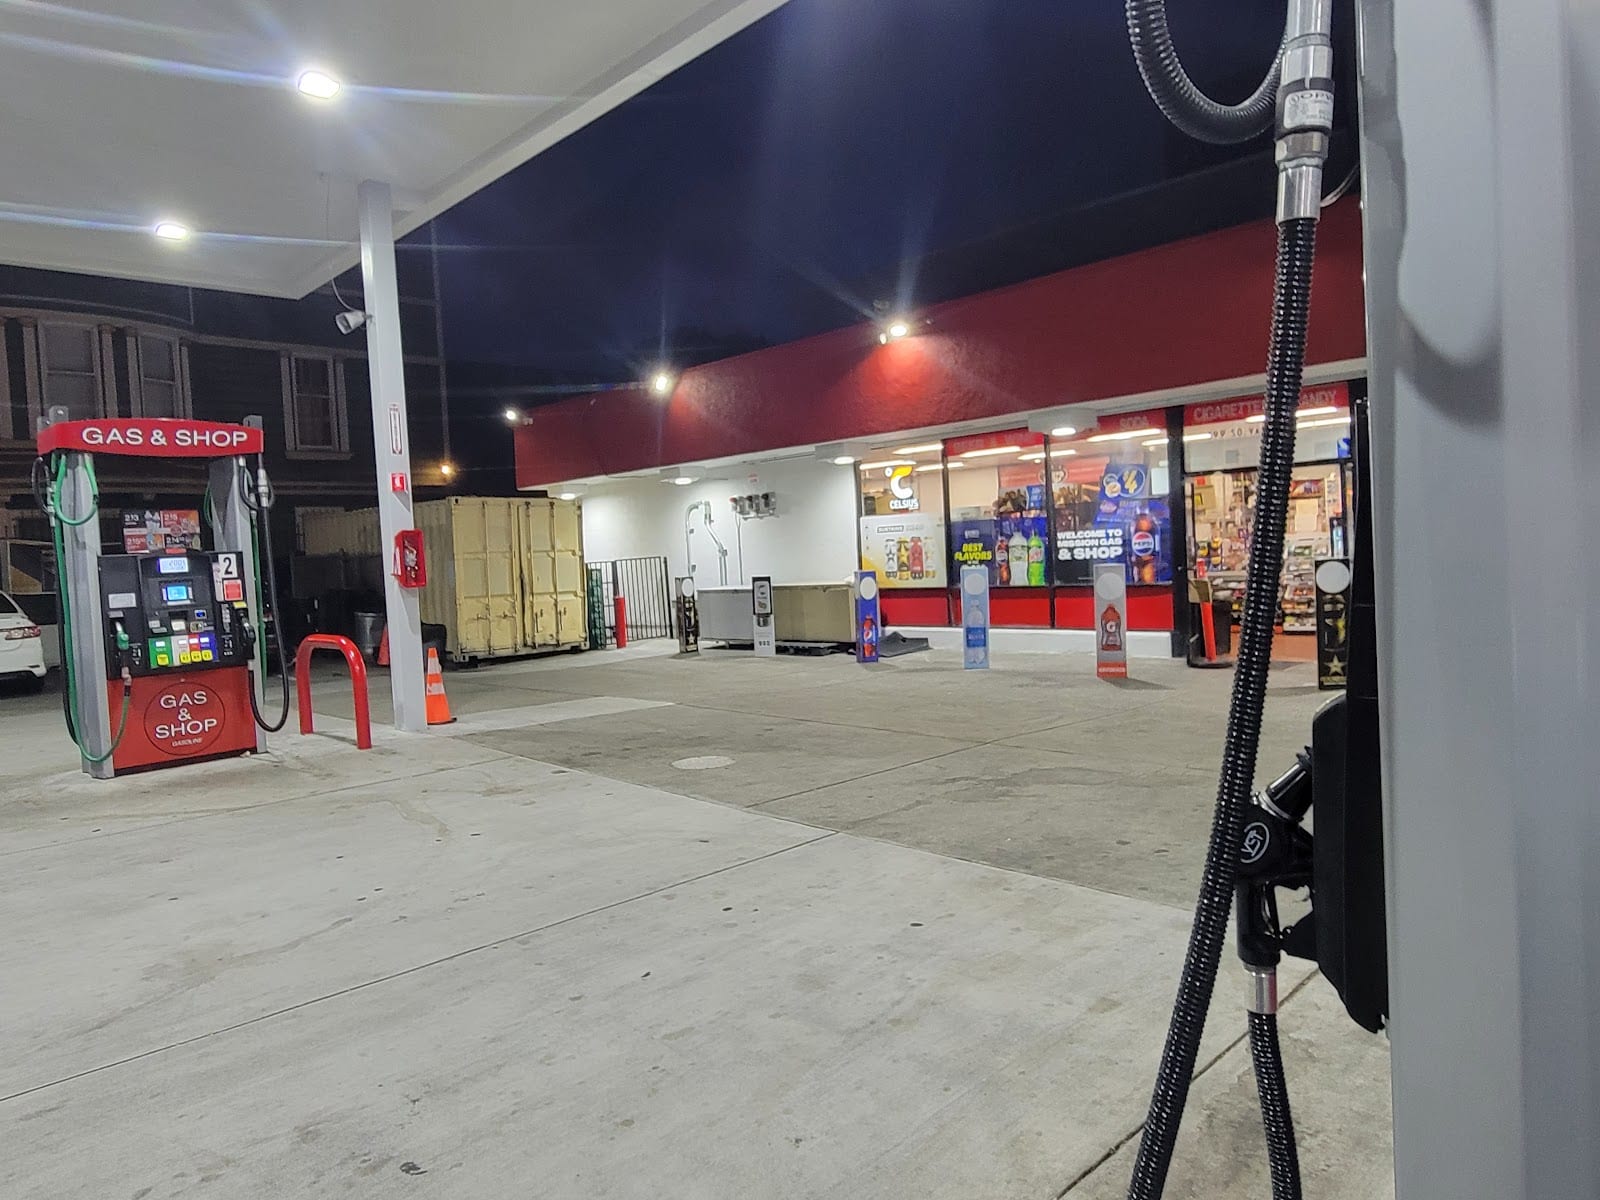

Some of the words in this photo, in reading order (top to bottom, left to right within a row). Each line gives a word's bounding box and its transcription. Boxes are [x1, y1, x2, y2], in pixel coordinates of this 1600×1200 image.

[1302, 390, 1336, 405] ANDY
[82, 427, 144, 445] GAS
[150, 428, 167, 445] &
[175, 430, 248, 447] SHOP
[889, 499, 919, 510] CELSIUS
[1057, 530, 1106, 539] WELCOME
[1107, 528, 1123, 537] TO
[962, 543, 983, 552] BEST
[1057, 538, 1099, 548] MISSION
[1099, 537, 1123, 546] GAS
[954, 551, 993, 561] FLAVORS
[1058, 548, 1072, 560] &
[1073, 546, 1123, 560] SHOP
[223, 556, 233, 575] 2
[160, 691, 207, 708] GAS
[178, 708, 192, 721] &
[155, 718, 218, 739] SHOP
